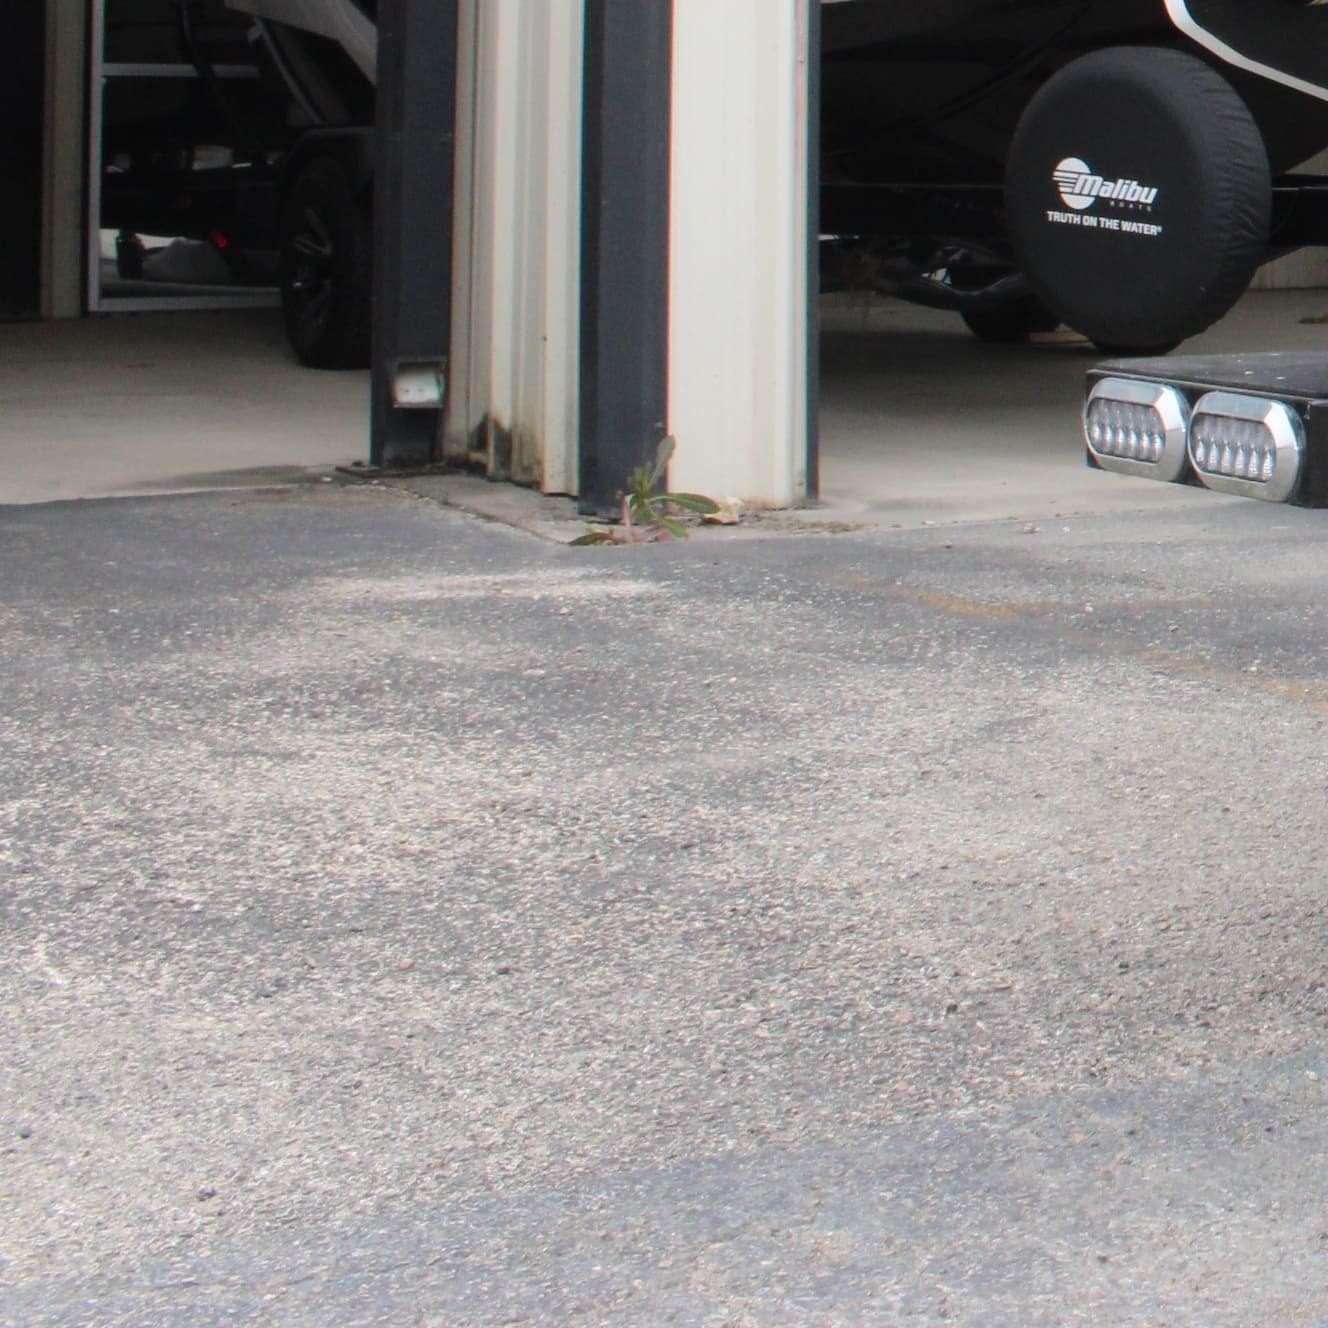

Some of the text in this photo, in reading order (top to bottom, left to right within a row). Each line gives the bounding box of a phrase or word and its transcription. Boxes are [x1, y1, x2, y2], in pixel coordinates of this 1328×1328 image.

[1073, 173, 1159, 204] Malibu
[1047, 211, 1081, 225] TRUTH
[1082, 215, 1098, 227] ON
[1099, 217, 1120, 231] THE
